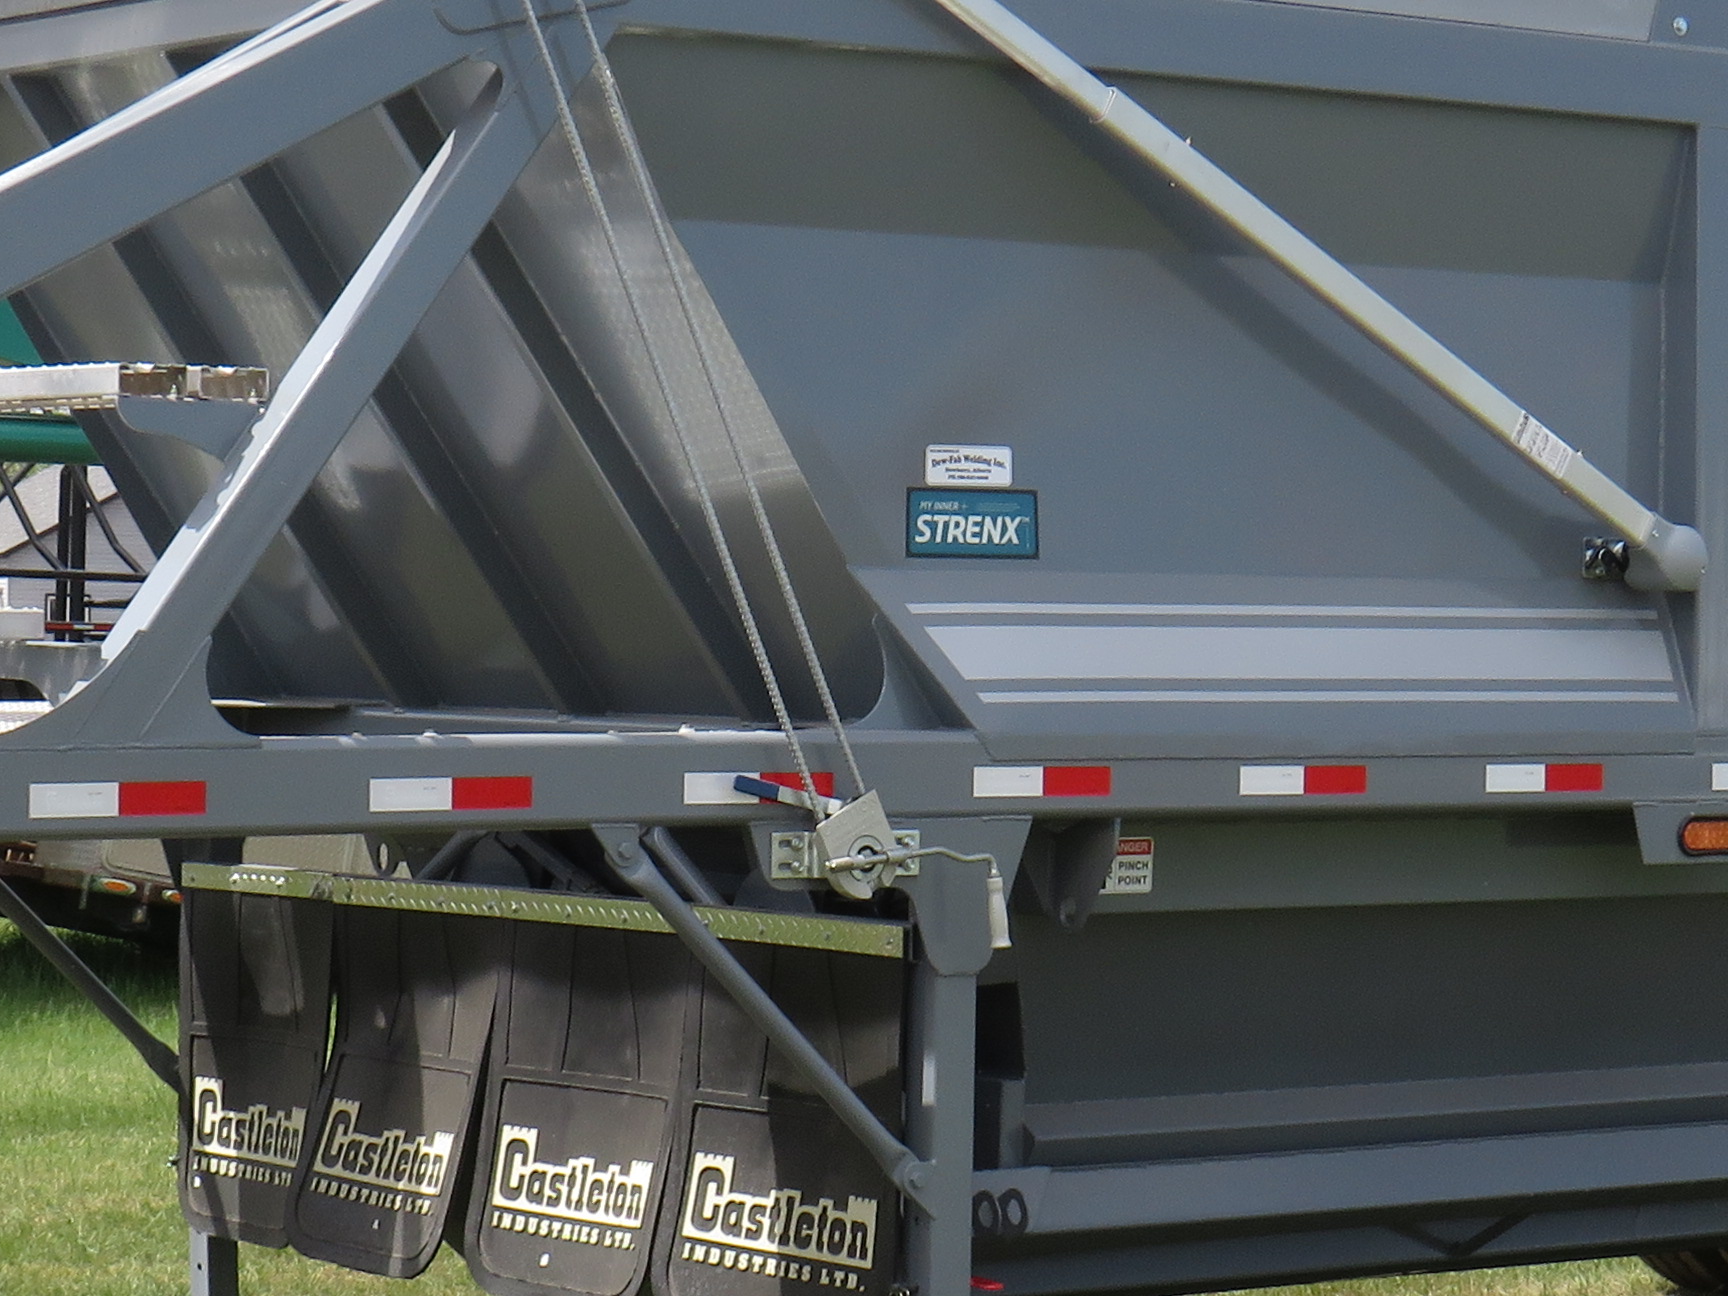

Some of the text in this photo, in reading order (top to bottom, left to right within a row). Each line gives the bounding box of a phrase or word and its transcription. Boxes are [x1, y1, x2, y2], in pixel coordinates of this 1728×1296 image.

[1118, 841, 1149, 853] NGER
[1117, 875, 1148, 886] POINT
[1118, 861, 1149, 871] PINCH
[196, 1086, 301, 1163] Castleton
[319, 1108, 446, 1189] Castleton
[192, 1154, 272, 1184] INDUSTRIES
[499, 1137, 643, 1221] Castleton
[309, 1176, 403, 1212] INDUSTRIES
[490, 1210, 600, 1246] INDUSTRIES
[690, 1164, 870, 1262] Castleton
[681, 1241, 865, 1292] INDUSTRIES LTD.
